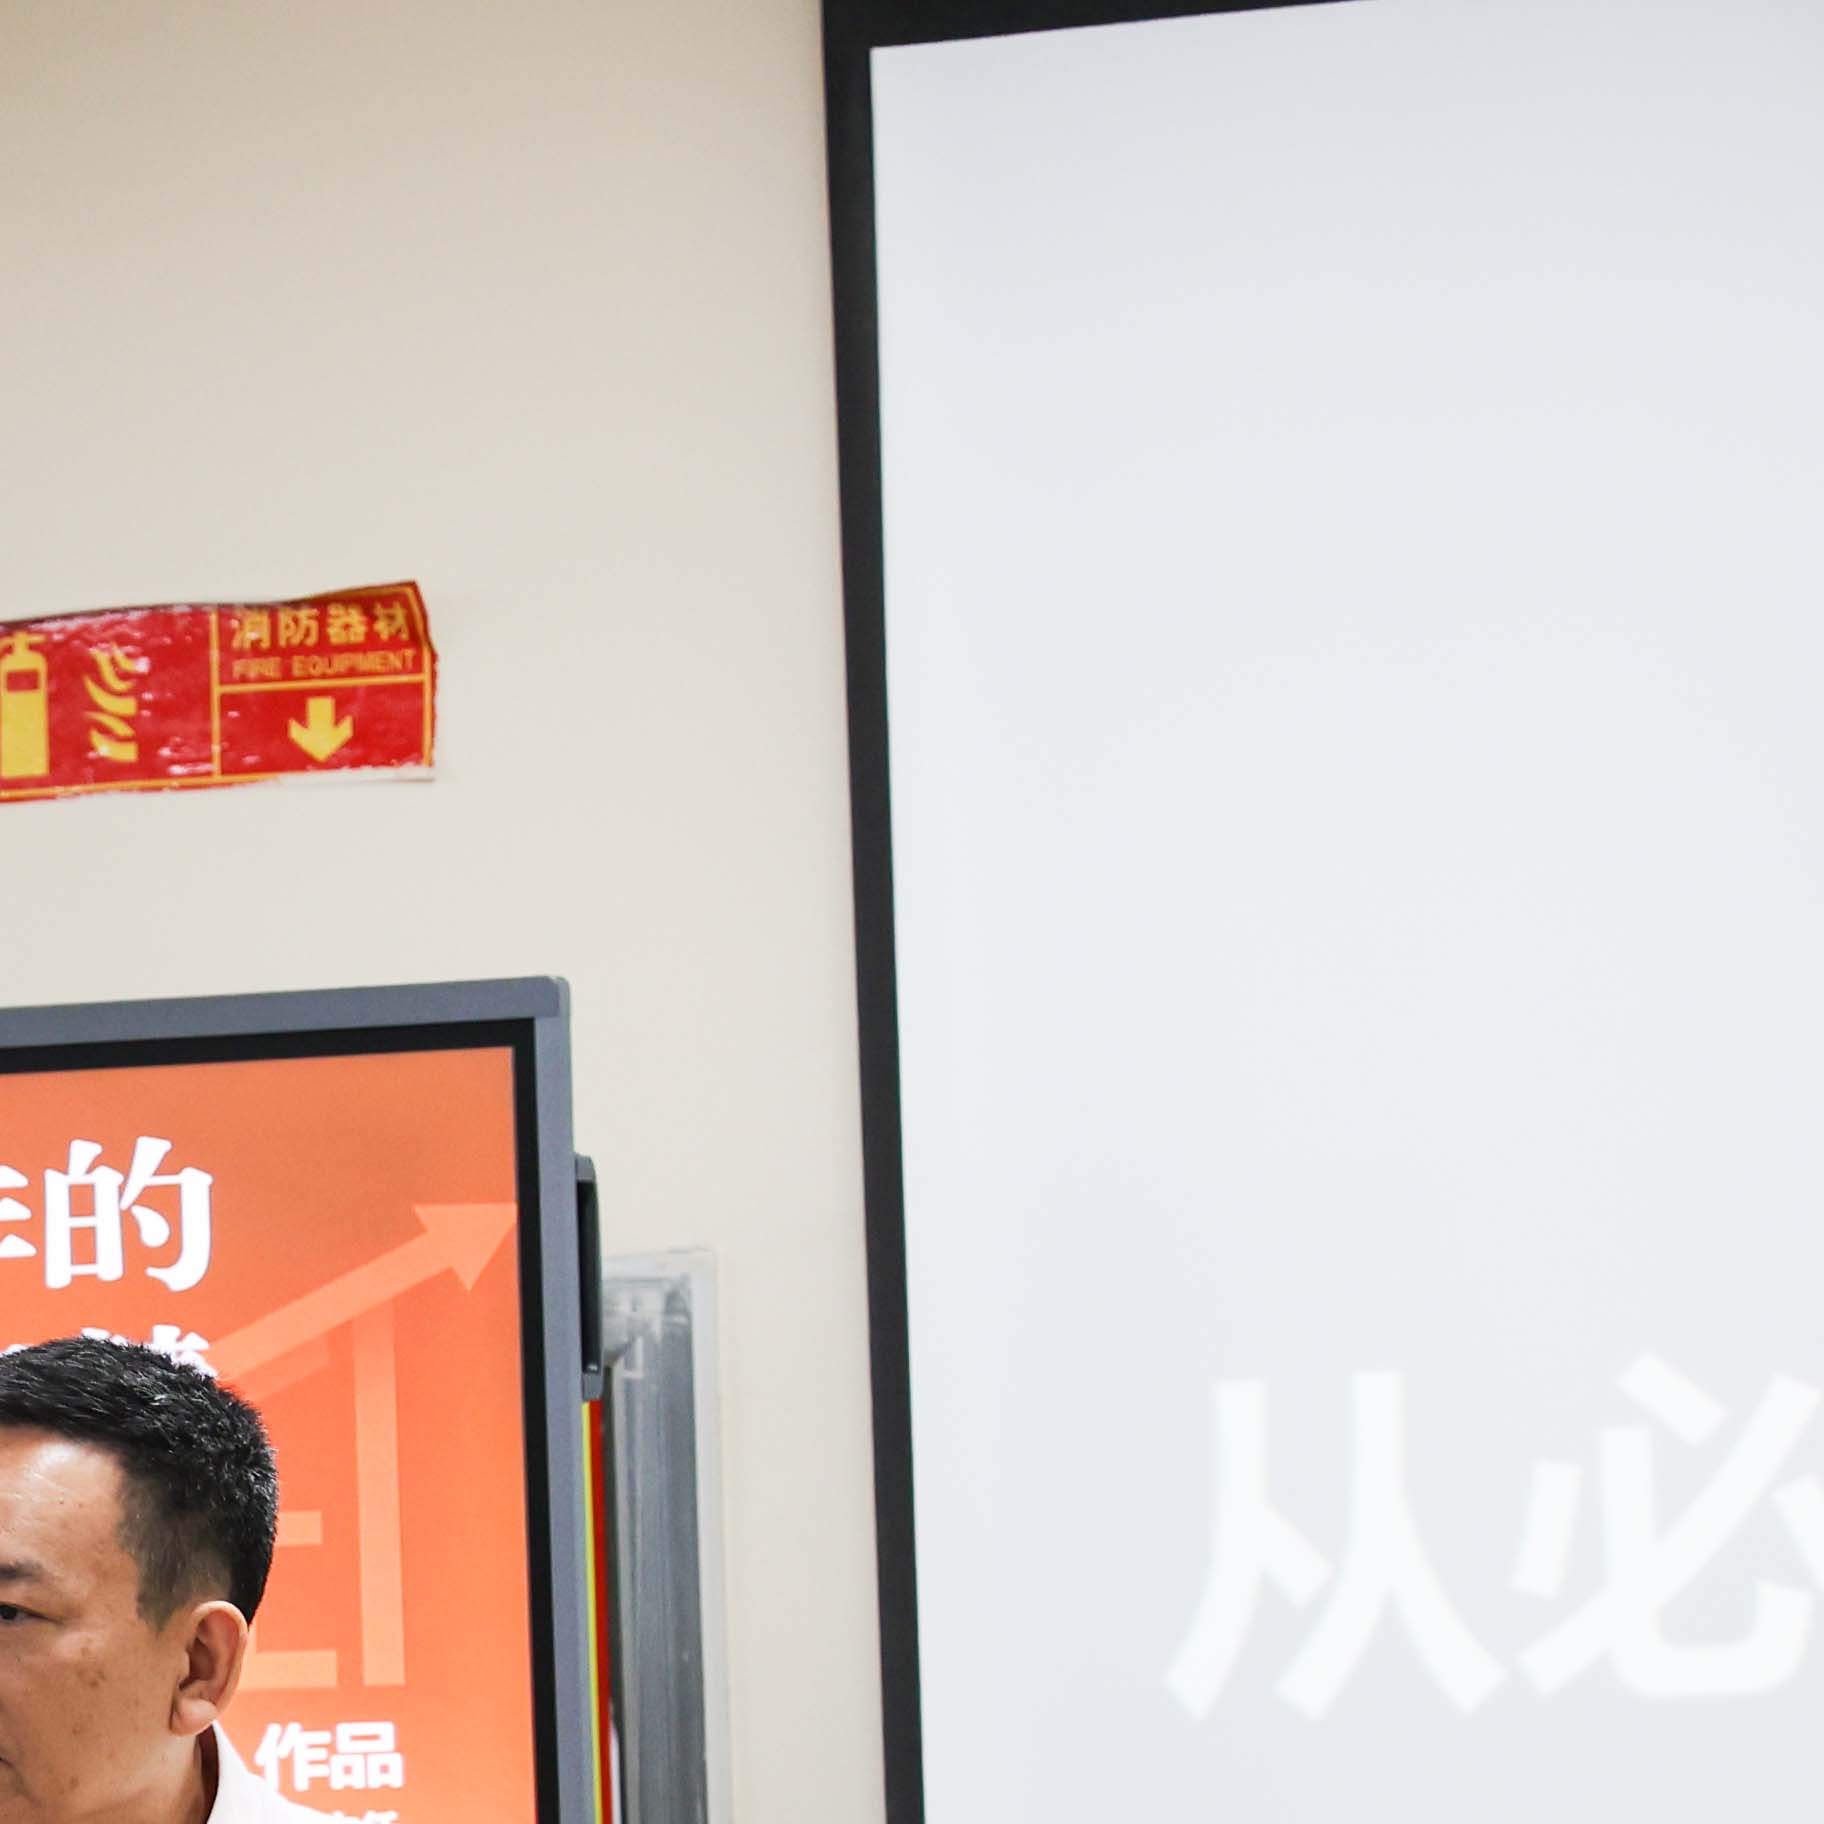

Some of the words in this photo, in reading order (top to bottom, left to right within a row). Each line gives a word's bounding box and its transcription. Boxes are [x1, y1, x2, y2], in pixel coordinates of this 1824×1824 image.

[231, 602, 410, 650] 消防器材
[232, 657, 282, 679] FIRE
[291, 648, 416, 677] EQUIPMENT
[255, 1721, 404, 1792] 作品
